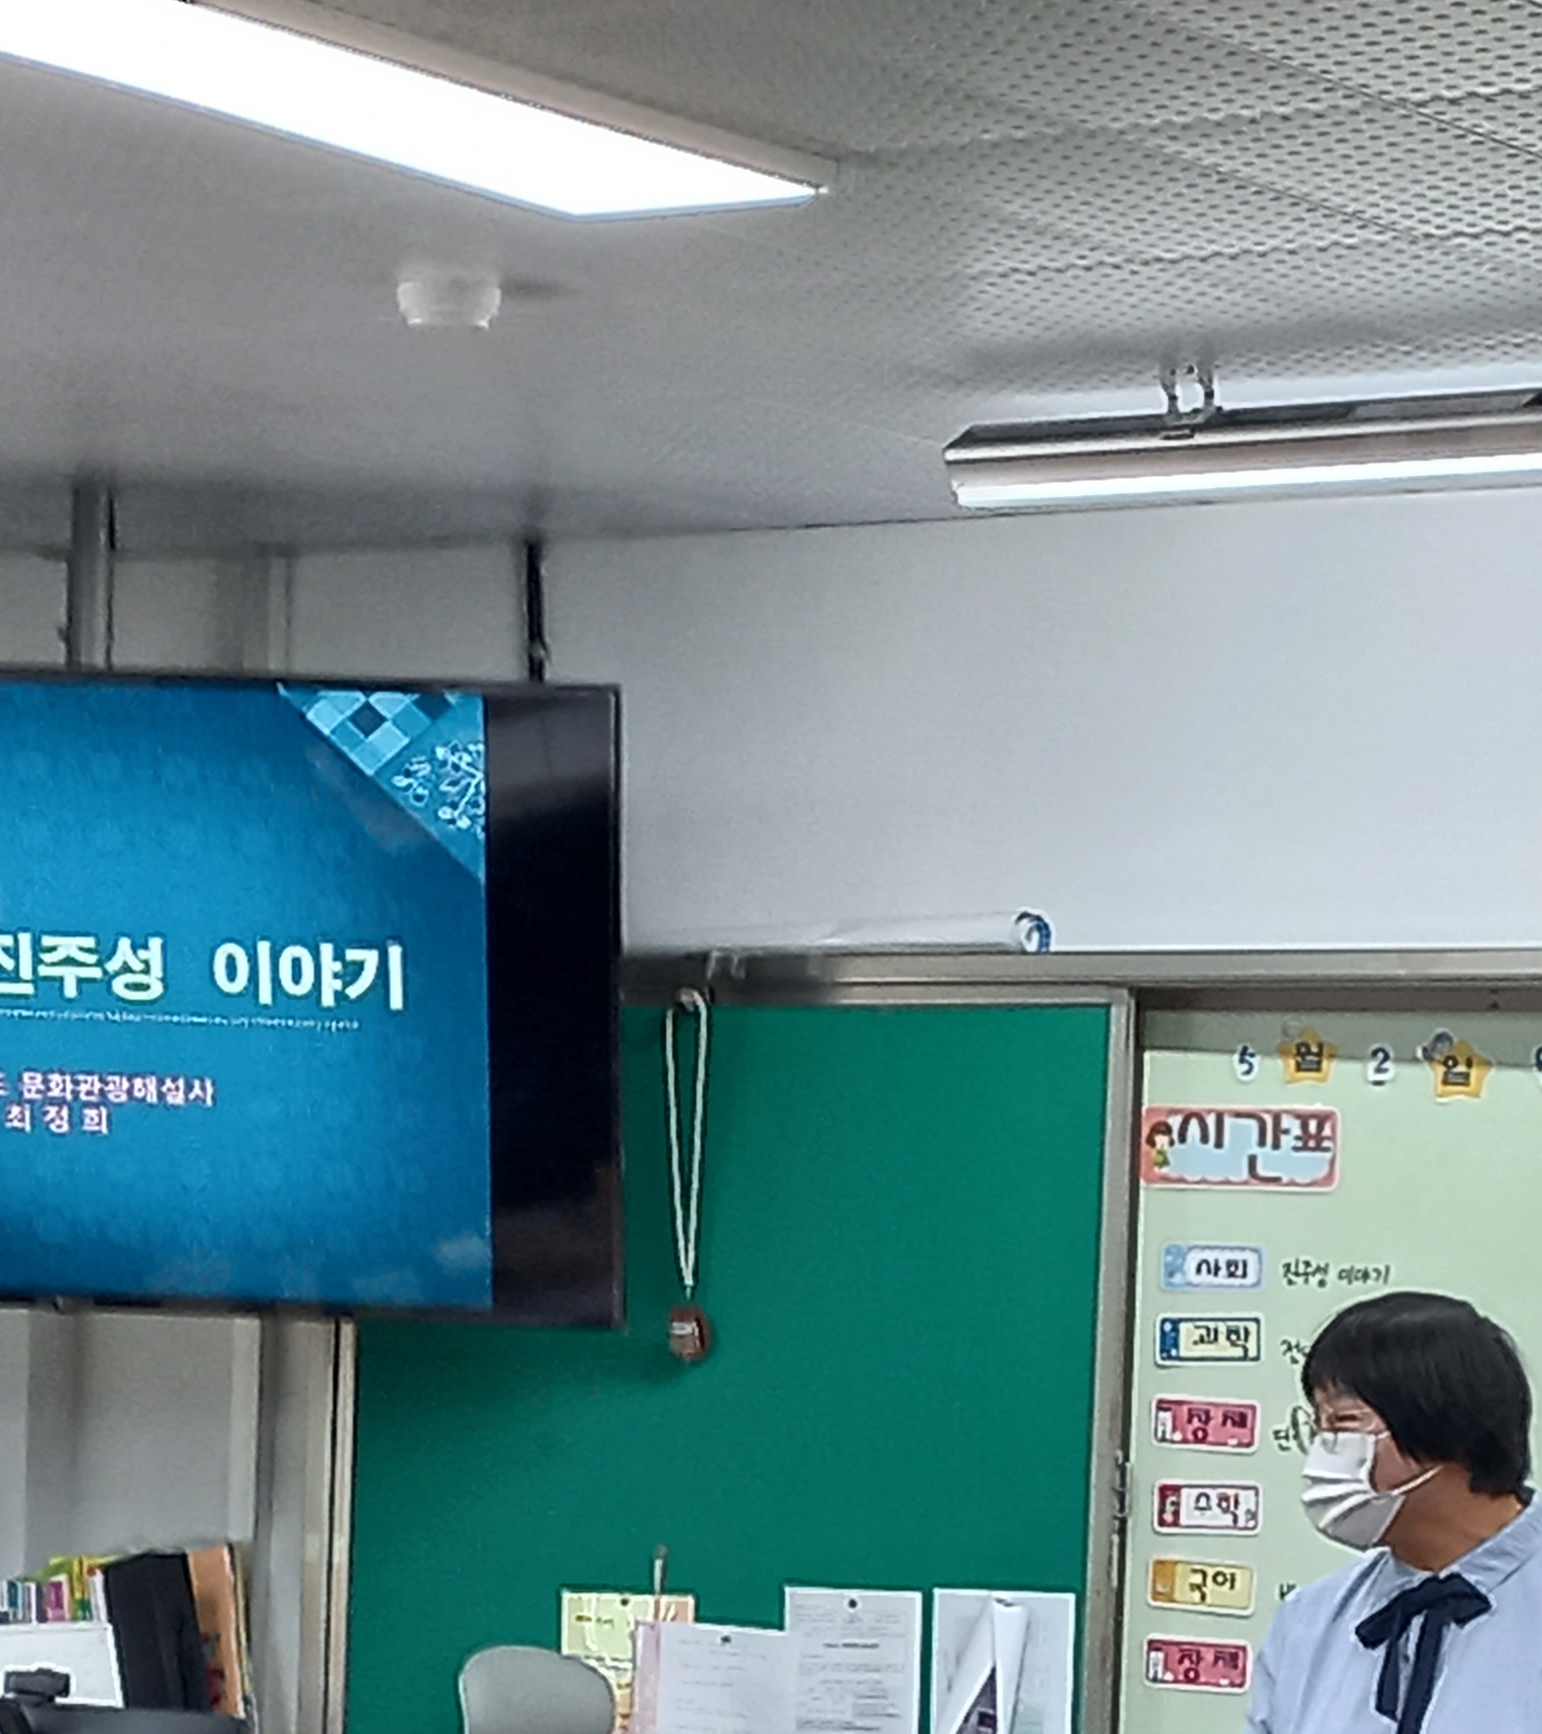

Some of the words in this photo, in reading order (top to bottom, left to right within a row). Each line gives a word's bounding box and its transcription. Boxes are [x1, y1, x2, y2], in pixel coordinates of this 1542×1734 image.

[212, 939, 406, 1011] 이야기
[1238, 1044, 1256, 1076] 5
[1370, 1046, 1391, 1075] 2
[20, 1070, 215, 1107] 문화관광해설사
[1177, 1110, 1333, 1184] 시간표
[1194, 1257, 1249, 1281] 사회
[1191, 1324, 1251, 1359] 과학
[1189, 1567, 1237, 1603] 국어
